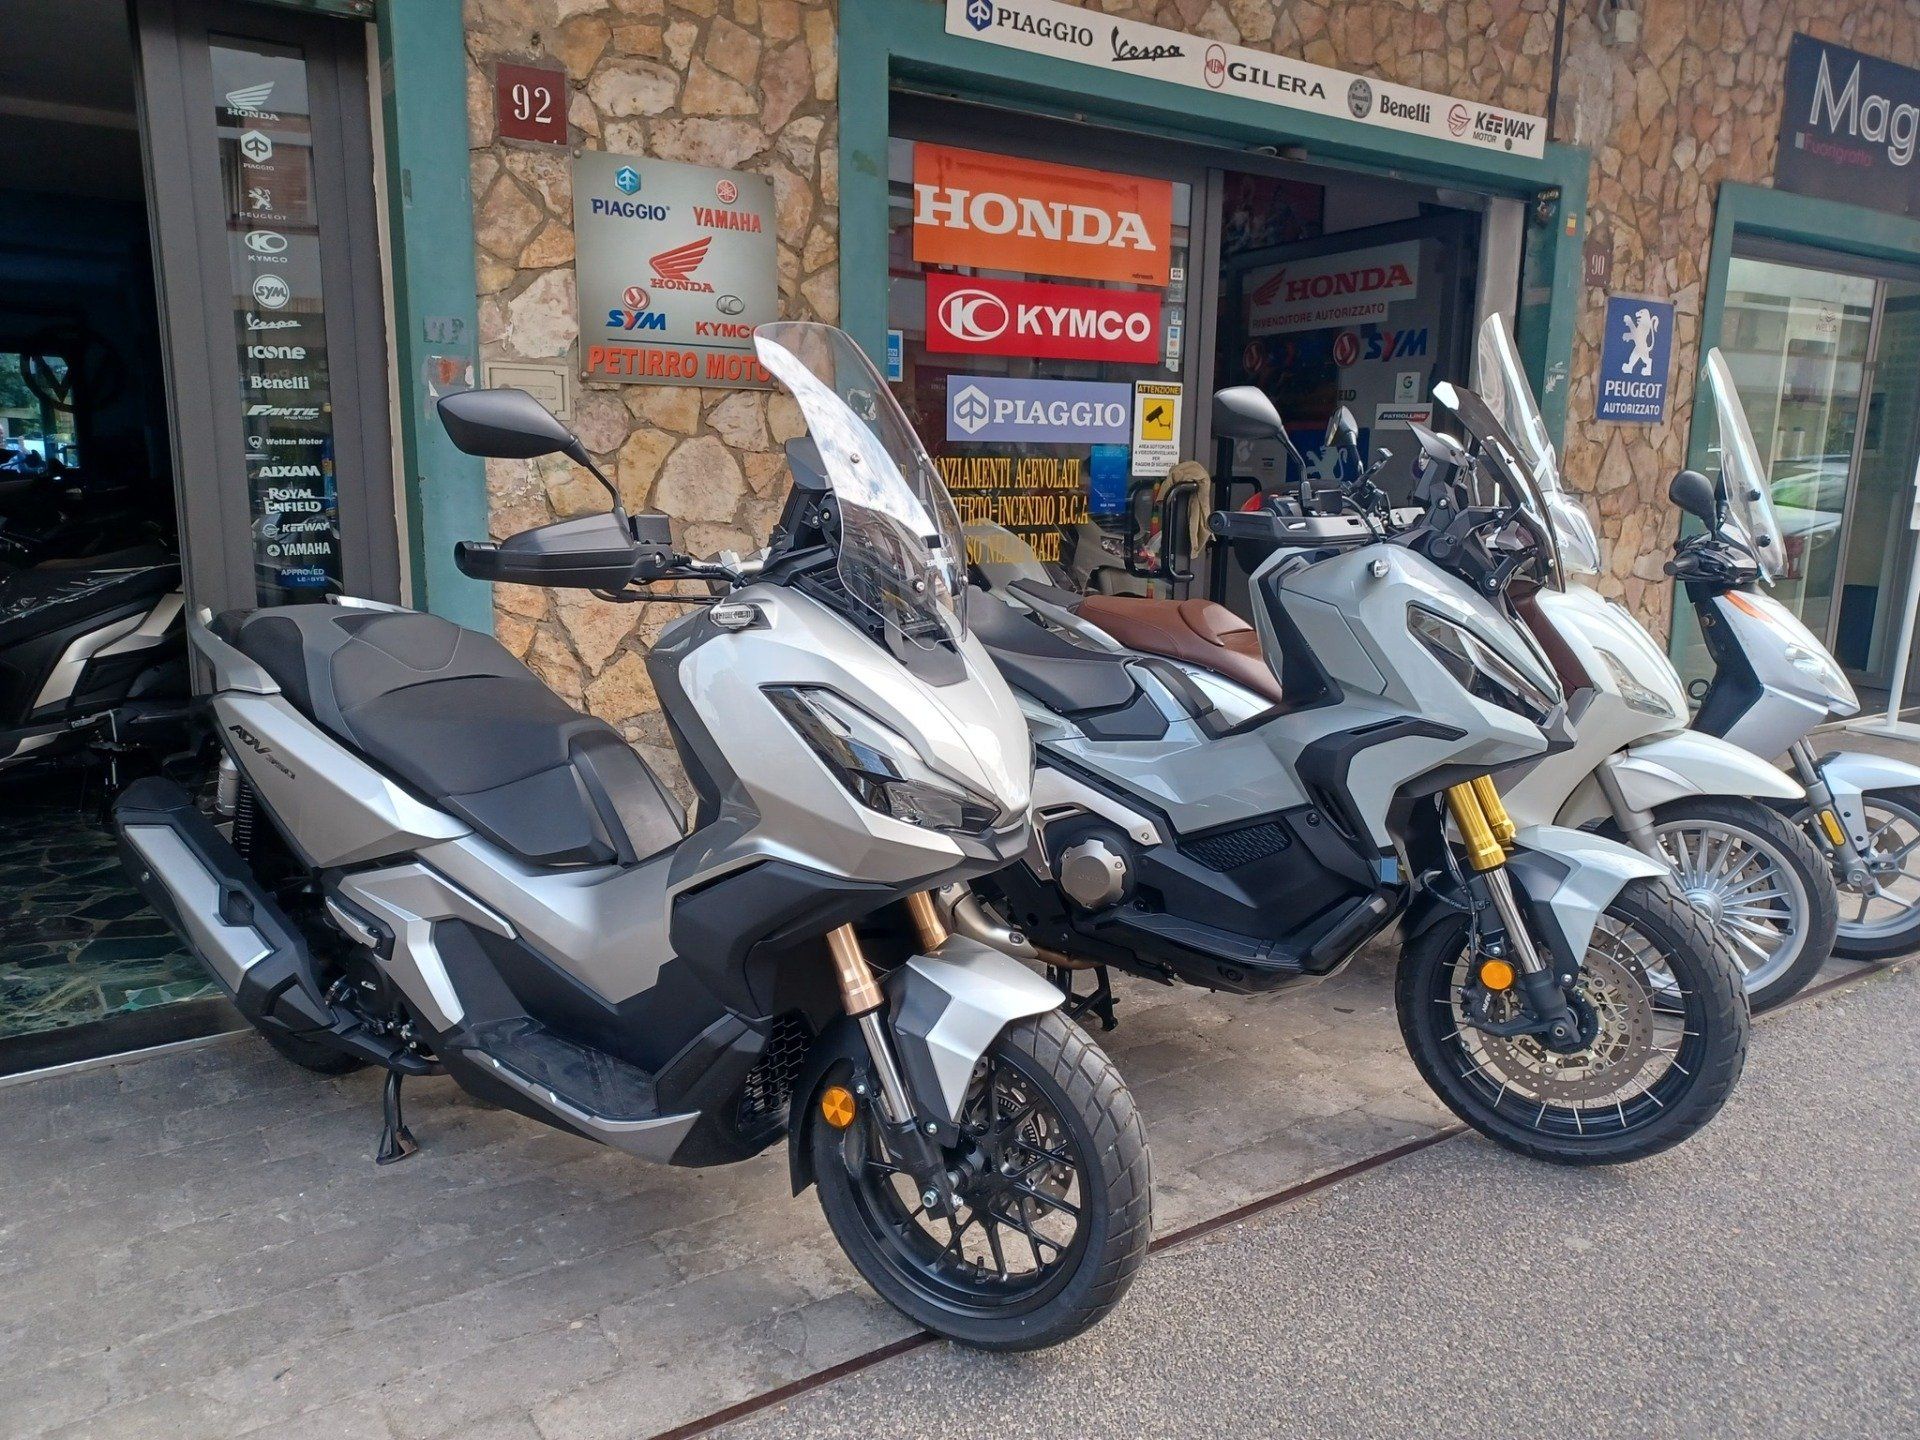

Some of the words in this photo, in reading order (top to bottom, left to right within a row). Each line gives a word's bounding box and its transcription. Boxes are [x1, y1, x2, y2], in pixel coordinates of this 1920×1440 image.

[997, 7, 1093, 47] PIAGGIO
[1111, 26, 1185, 61] Vespa
[1227, 62, 1326, 99] GILERA
[511, 83, 552, 124] 92
[1379, 94, 1431, 123] Benelli
[226, 107, 280, 122] HONDA
[1474, 111, 1536, 141] KEEWAY
[1472, 131, 1497, 144] MOTOR
[242, 163, 275, 171] PIAGGIO
[239, 212, 287, 220] PEUGEOT
[590, 198, 667, 221] PIAGGIO
[692, 206, 762, 233] YAMAHA
[914, 183, 1157, 252] HONDA
[247, 255, 288, 263] KYMCO
[1591, 254, 1605, 276] 90
[256, 285, 287, 299] SYM
[650, 277, 715, 293] HONDA
[1285, 263, 1413, 302] HONDA
[246, 312, 301, 330] Vespa
[606, 309, 667, 331] SYM
[1016, 303, 1151, 342] KYMCO
[1251, 312, 1312, 329] RIVENDITORE
[1315, 302, 1385, 320] AUTORIZZATO
[695, 321, 757, 339] KYMC
[1363, 328, 1428, 362] SYM
[587, 345, 698, 378] PETIRRO
[250, 375, 310, 389] Benelli
[1138, 385, 1180, 395] ATTENZIONE
[1604, 380, 1663, 399] PEUGEOT
[246, 404, 320, 416] FANTIC
[993, 398, 1126, 428] PIAGGIO
[1603, 402, 1660, 415] AUTORIZZATO
[258, 465, 321, 477] AIXAM
[1014, 457, 1081, 489] AGEVOLATI
[268, 487, 316, 500] ROYAL
[263, 500, 322, 515] ENFIELD
[282, 522, 331, 533] KEEWAY
[281, 542, 331, 555] YAMAHA
[1030, 532, 1060, 563] RATE
[281, 566, 325, 576] APPROVED
[228, 724, 272, 754] ADV
